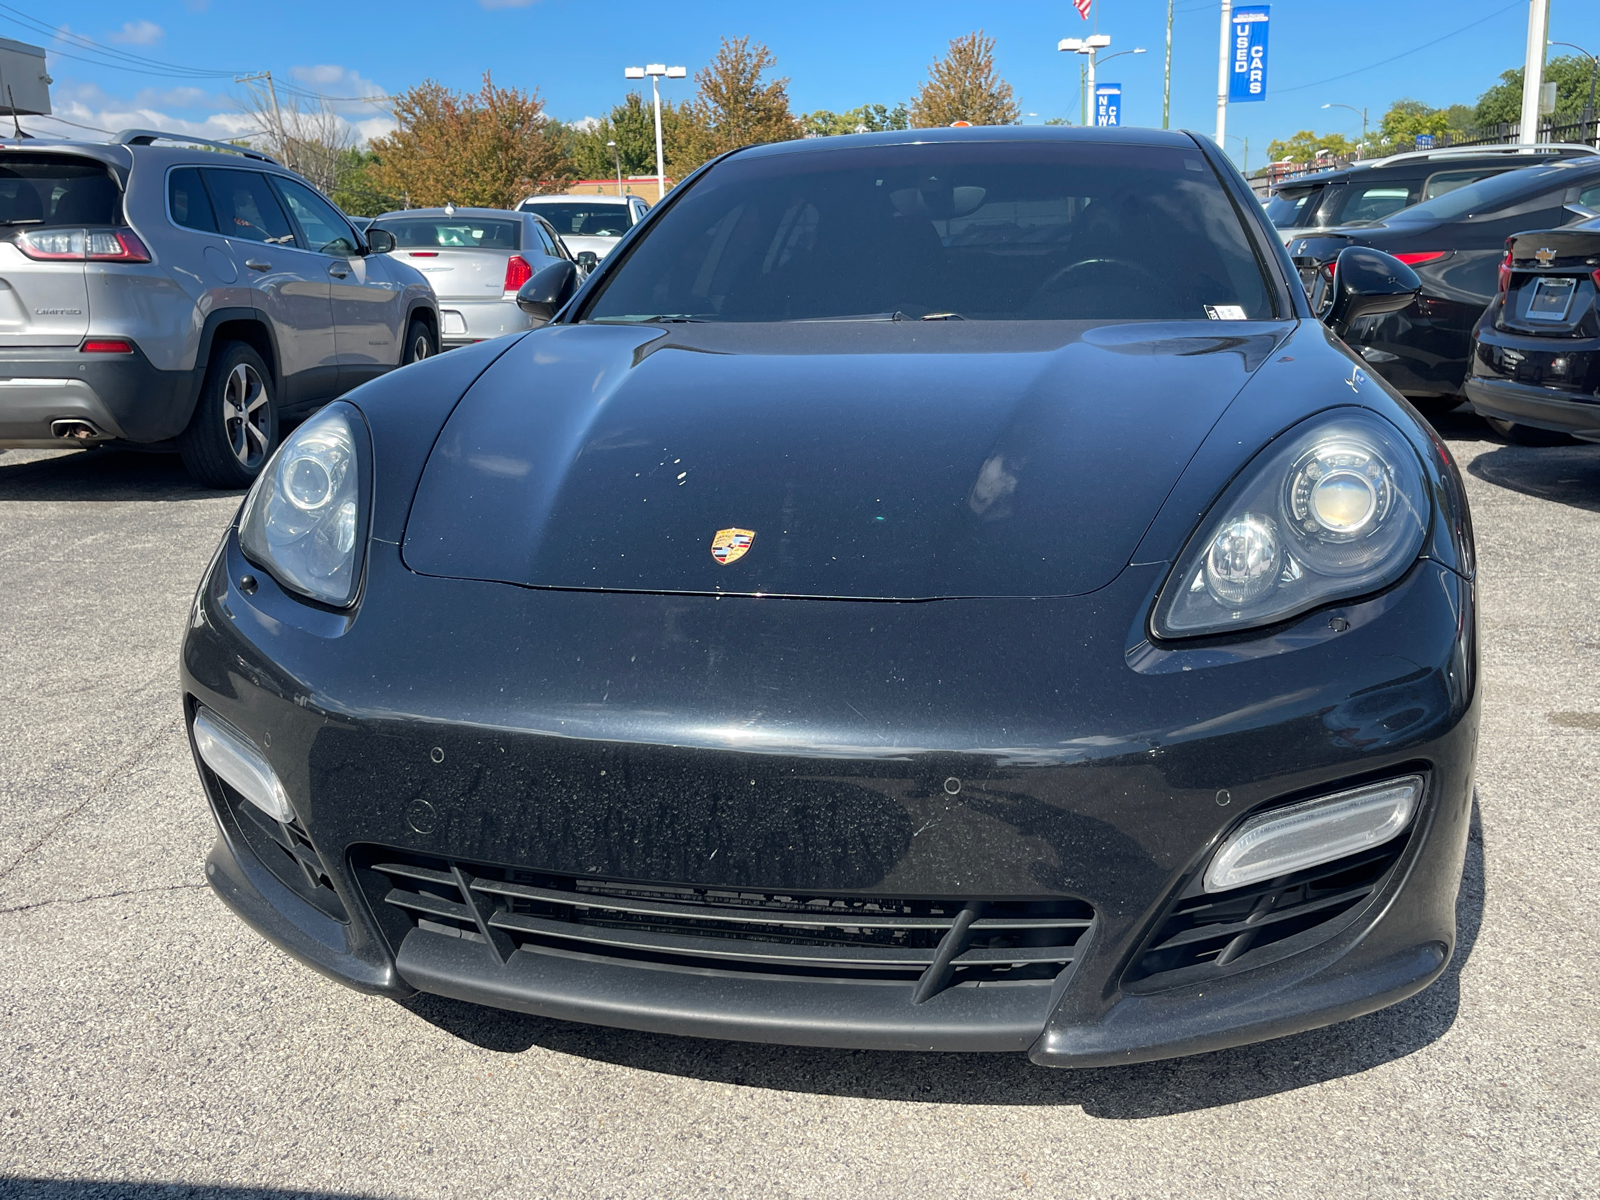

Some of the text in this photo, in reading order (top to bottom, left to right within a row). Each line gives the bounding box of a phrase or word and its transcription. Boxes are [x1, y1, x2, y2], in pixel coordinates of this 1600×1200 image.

[1235, 24, 1263, 94] USED CARS
[1098, 96, 1108, 127] NEW
